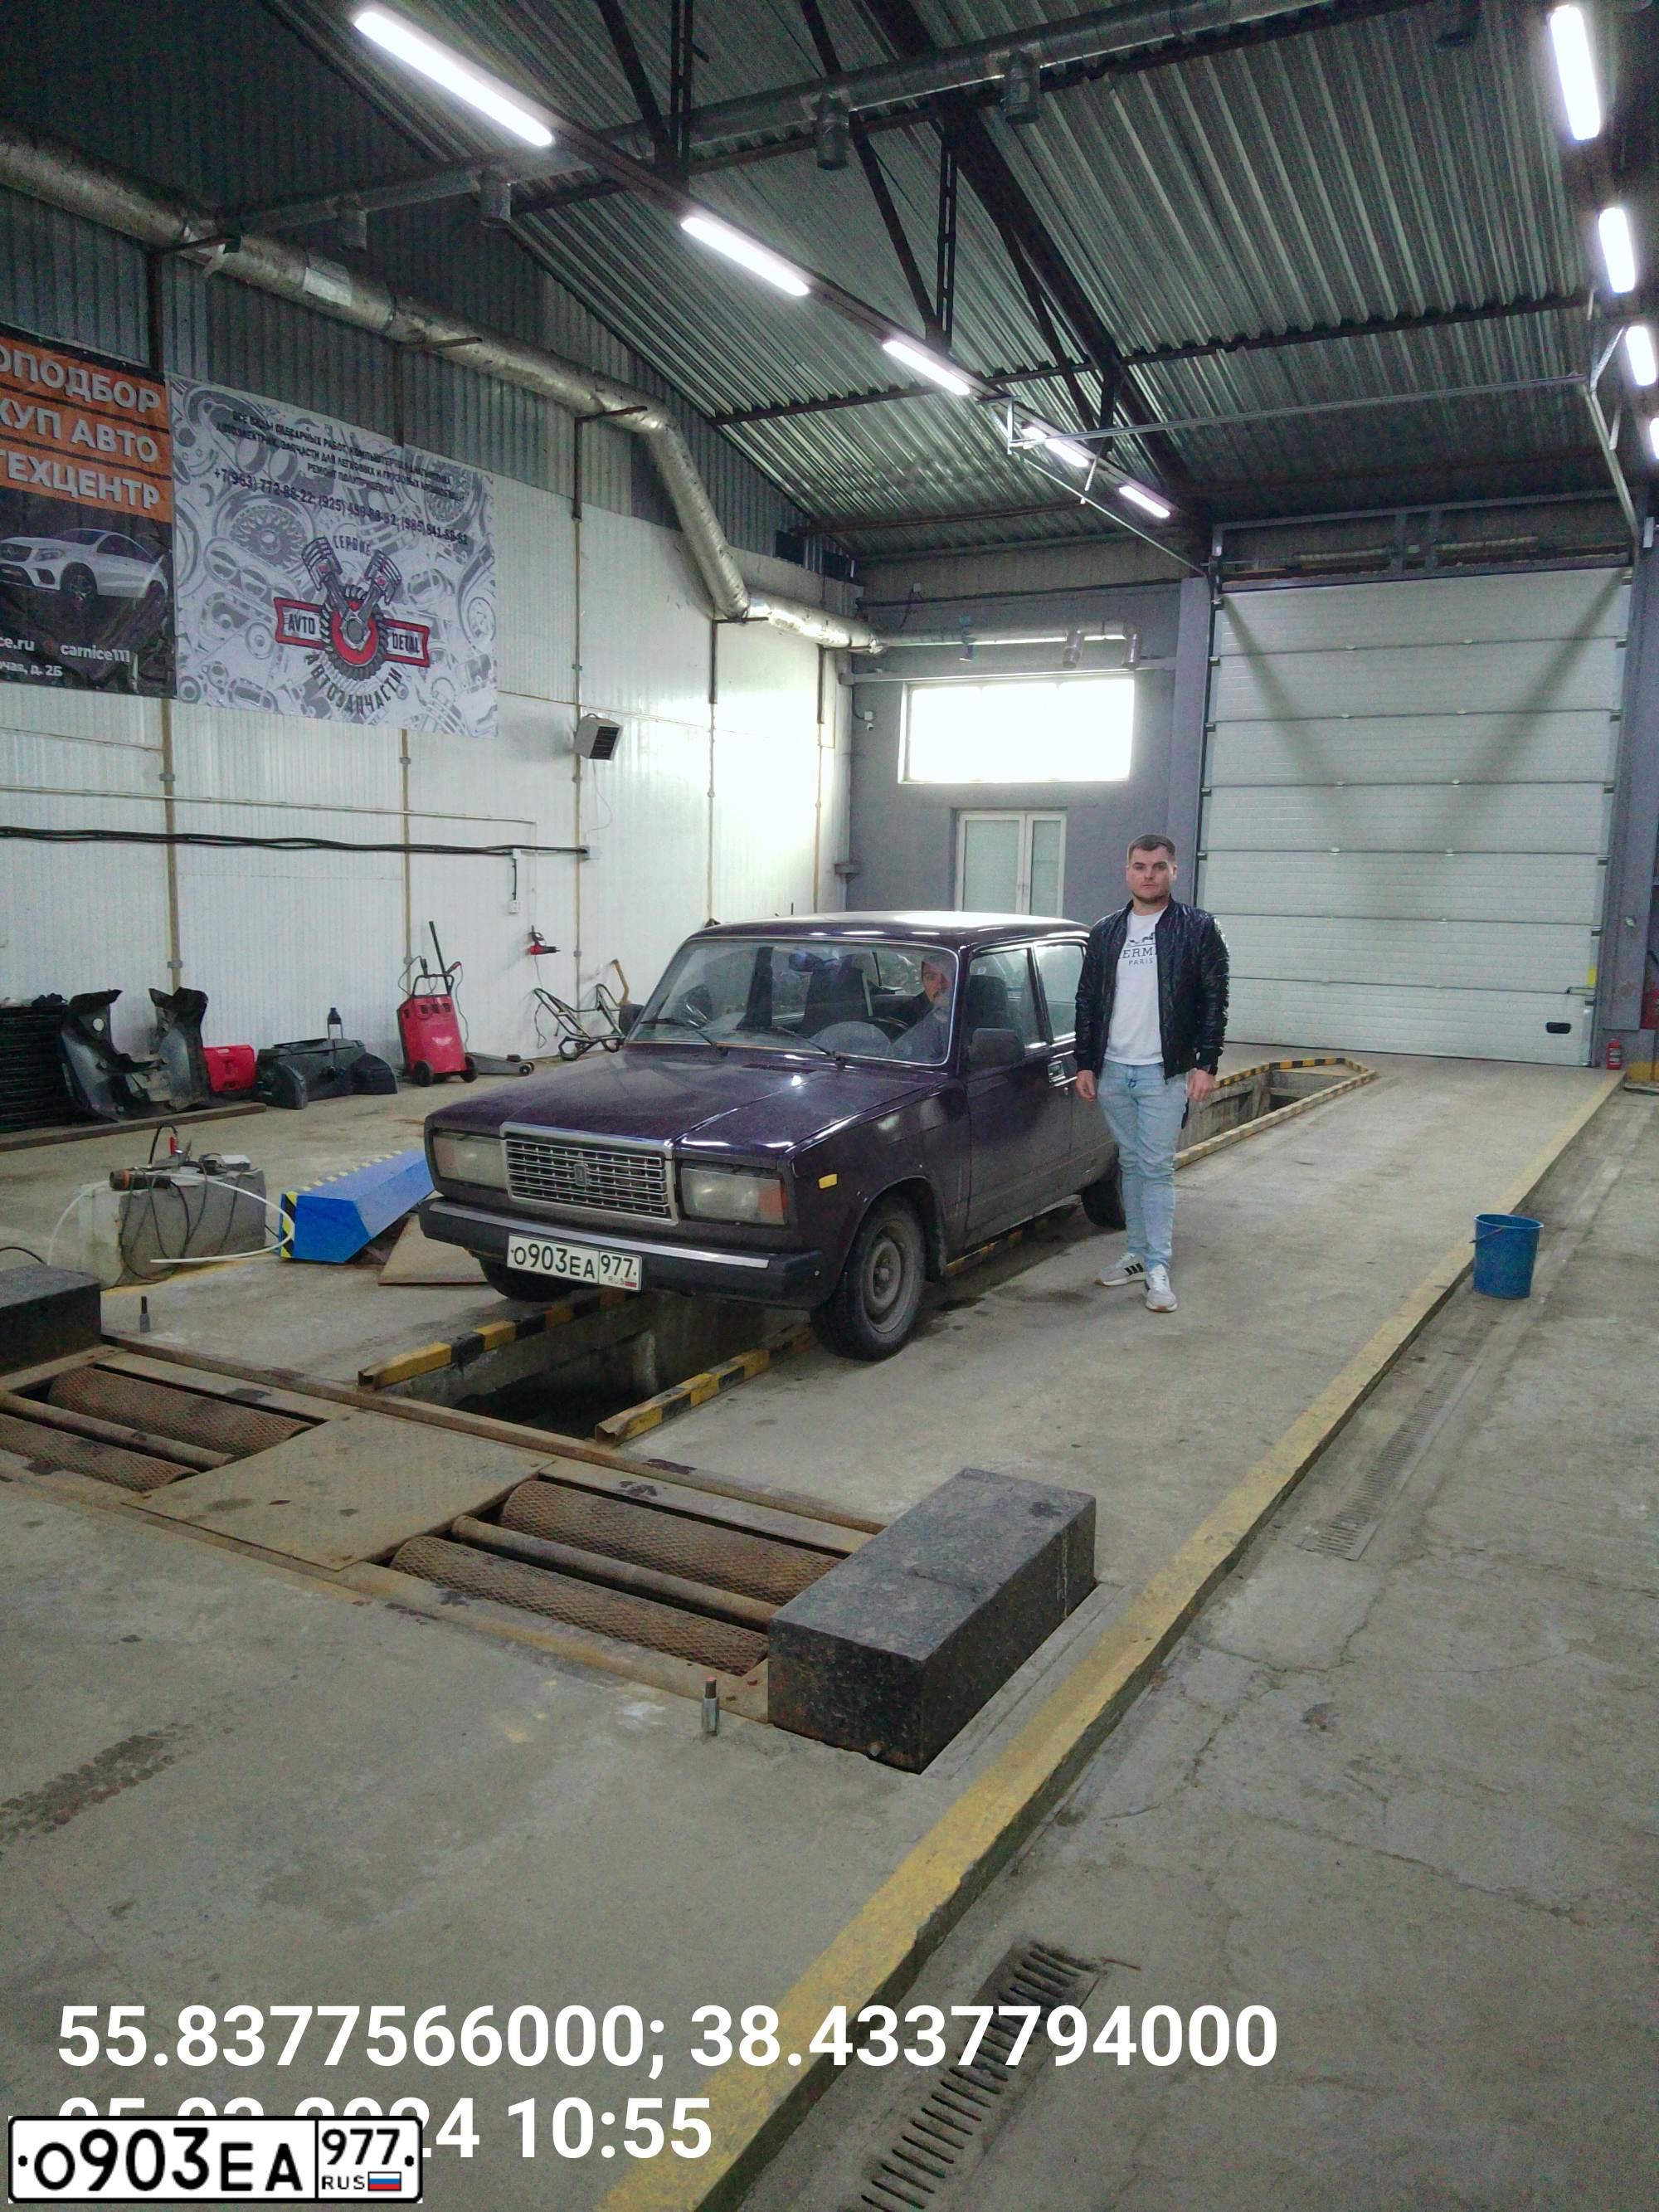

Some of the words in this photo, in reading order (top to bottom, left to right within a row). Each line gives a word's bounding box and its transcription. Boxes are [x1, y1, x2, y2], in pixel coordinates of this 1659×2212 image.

[71, 419, 158, 463] АВТО
[0, 449, 160, 509] ЕХЦЕНТР
[288, 613, 316, 635] AVTO
[392, 632, 421, 654] DETAL
[45, 665, 64, 676] 2Б
[304, 653, 403, 714] АВТОЗАПЧАСТИ
[601, 1255, 633, 1278] 977
[608, 1277, 625, 1285] RUS
